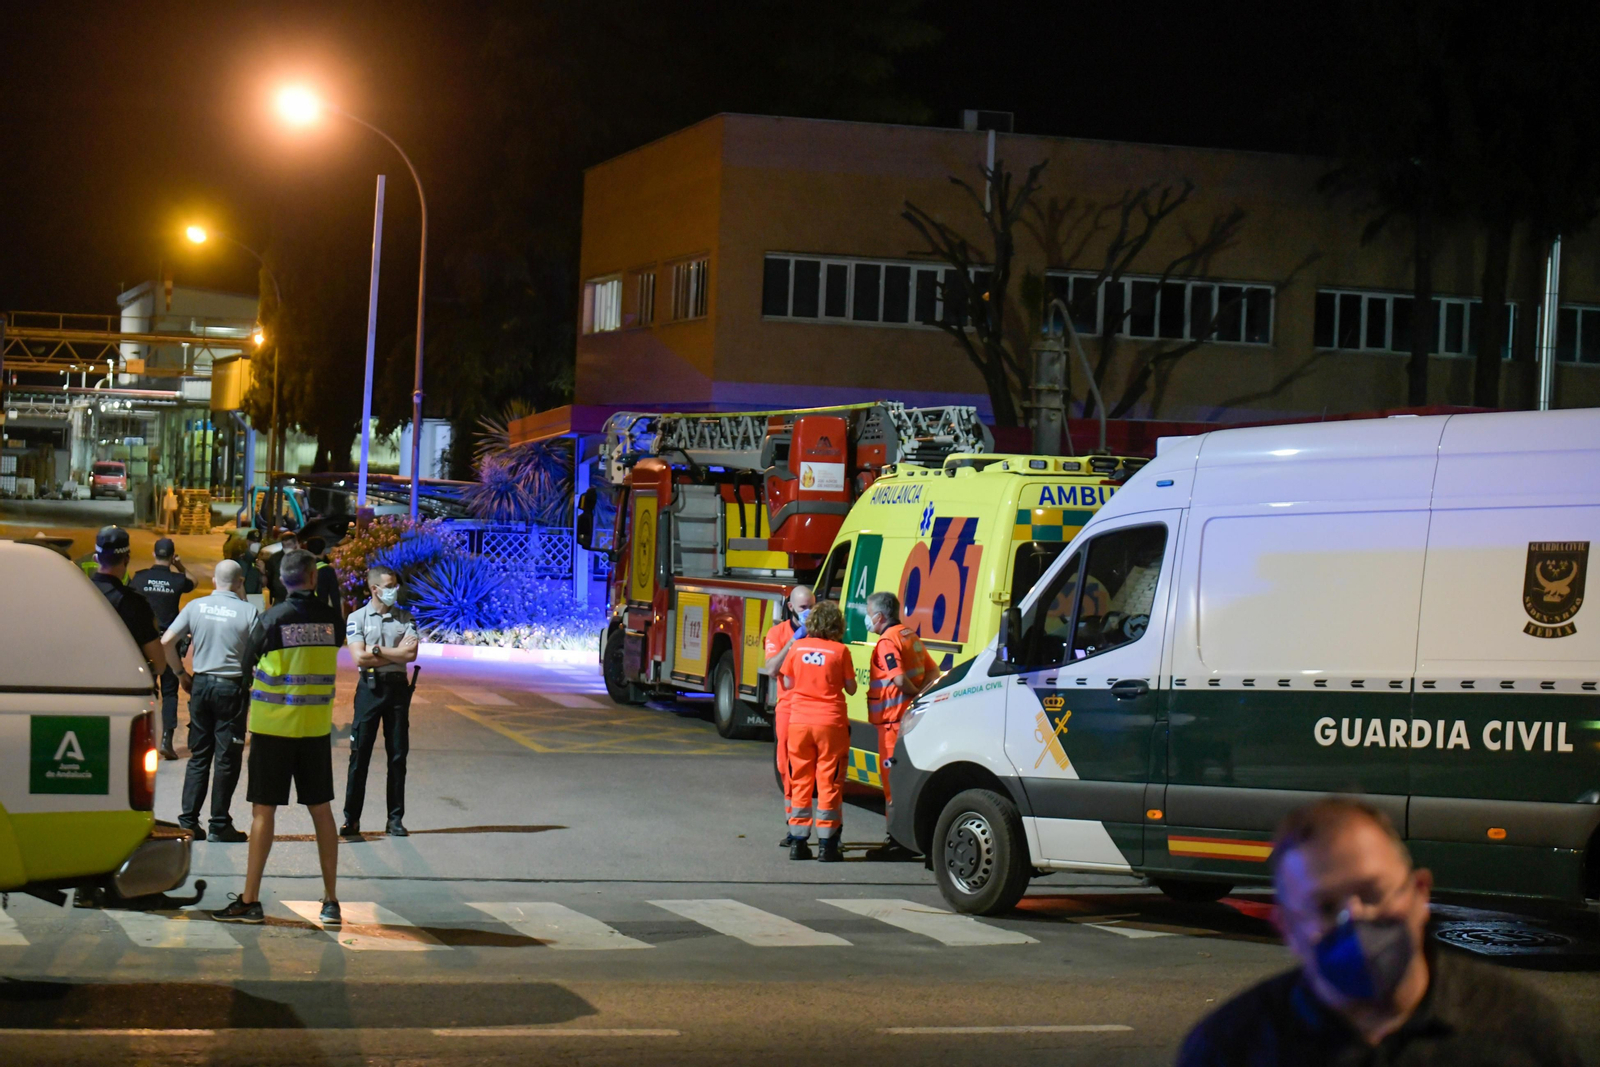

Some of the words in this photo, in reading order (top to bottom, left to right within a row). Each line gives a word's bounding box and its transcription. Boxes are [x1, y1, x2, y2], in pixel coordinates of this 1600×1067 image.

[870, 484, 923, 505] AMBULANCIA
[1530, 542, 1564, 552] GUARDIA
[1564, 542, 1586, 551] CIVIL
[898, 516, 984, 645] 061
[143, 586, 175, 594] GRANADA
[198, 603, 237, 618] Trablisa
[689, 620, 701, 639] 112
[1528, 624, 1574, 638] TEDAX
[801, 651, 826, 667] 061
[952, 685, 984, 698] GUARDIA
[985, 680, 1003, 691] CIVIL
[1313, 716, 1471, 750] GUARDIA
[1482, 719, 1574, 752] CIVIL
